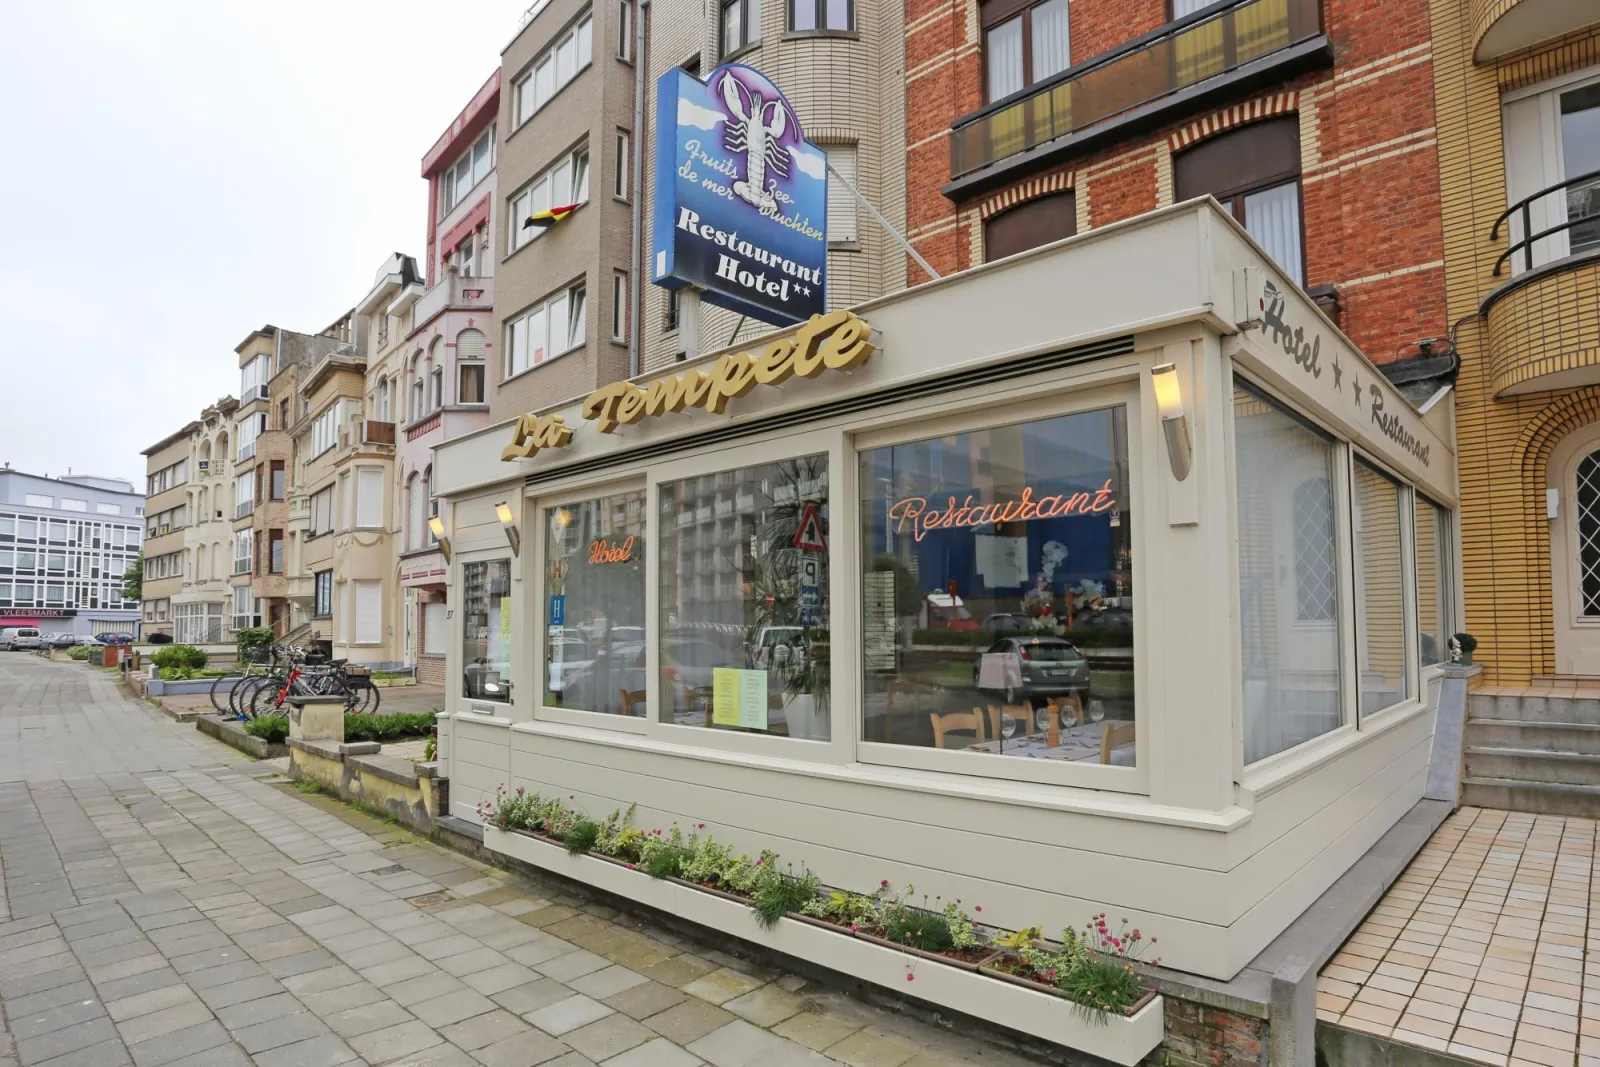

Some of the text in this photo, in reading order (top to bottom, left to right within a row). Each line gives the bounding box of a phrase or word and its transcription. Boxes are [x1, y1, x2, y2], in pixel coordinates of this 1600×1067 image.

[678, 160, 734, 200] de mer
[685, 139, 739, 179] Fruits
[758, 205, 824, 241] vruchten
[676, 206, 823, 286] Restaurant
[715, 253, 790, 302] Hotel
[1262, 297, 1430, 467] Hotel Restaurant
[501, 413, 570, 462] La
[889, 478, 1116, 542] Restaurant
[588, 535, 634, 564] Hotel
[4, 609, 65, 617] VLEESMARKT
